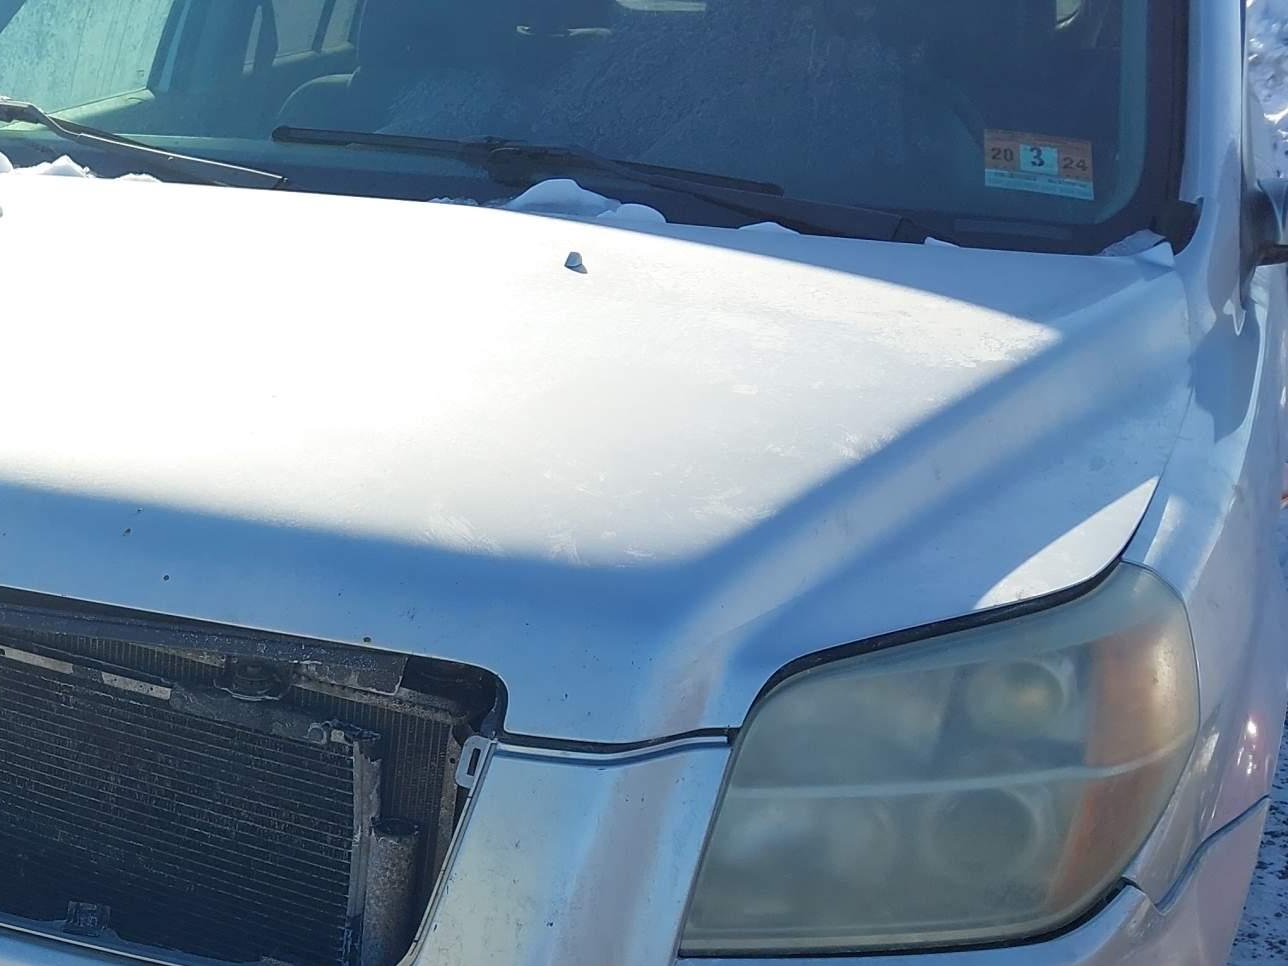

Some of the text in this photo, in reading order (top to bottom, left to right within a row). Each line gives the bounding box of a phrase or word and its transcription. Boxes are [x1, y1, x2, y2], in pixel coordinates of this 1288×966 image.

[991, 146, 1088, 171] 20 3 24
